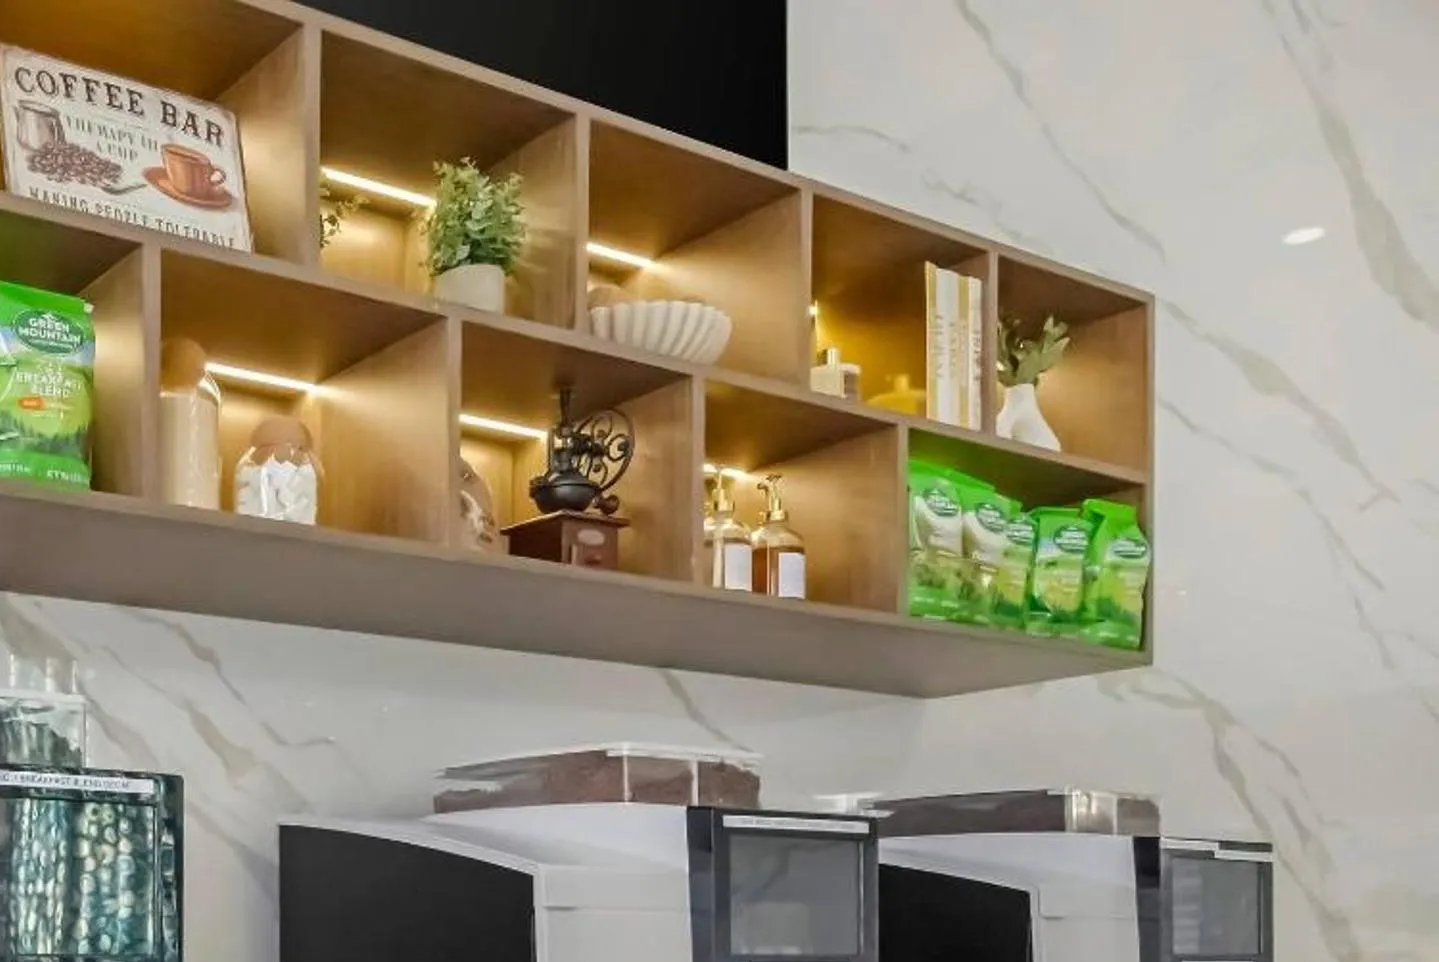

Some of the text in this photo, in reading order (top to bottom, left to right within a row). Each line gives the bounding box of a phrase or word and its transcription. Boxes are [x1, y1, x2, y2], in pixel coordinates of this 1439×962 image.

[14, 66, 224, 147] COFFEE BAR
[29, 318, 69, 333] GREEN
[18, 326, 81, 345] MOUNTAIN
